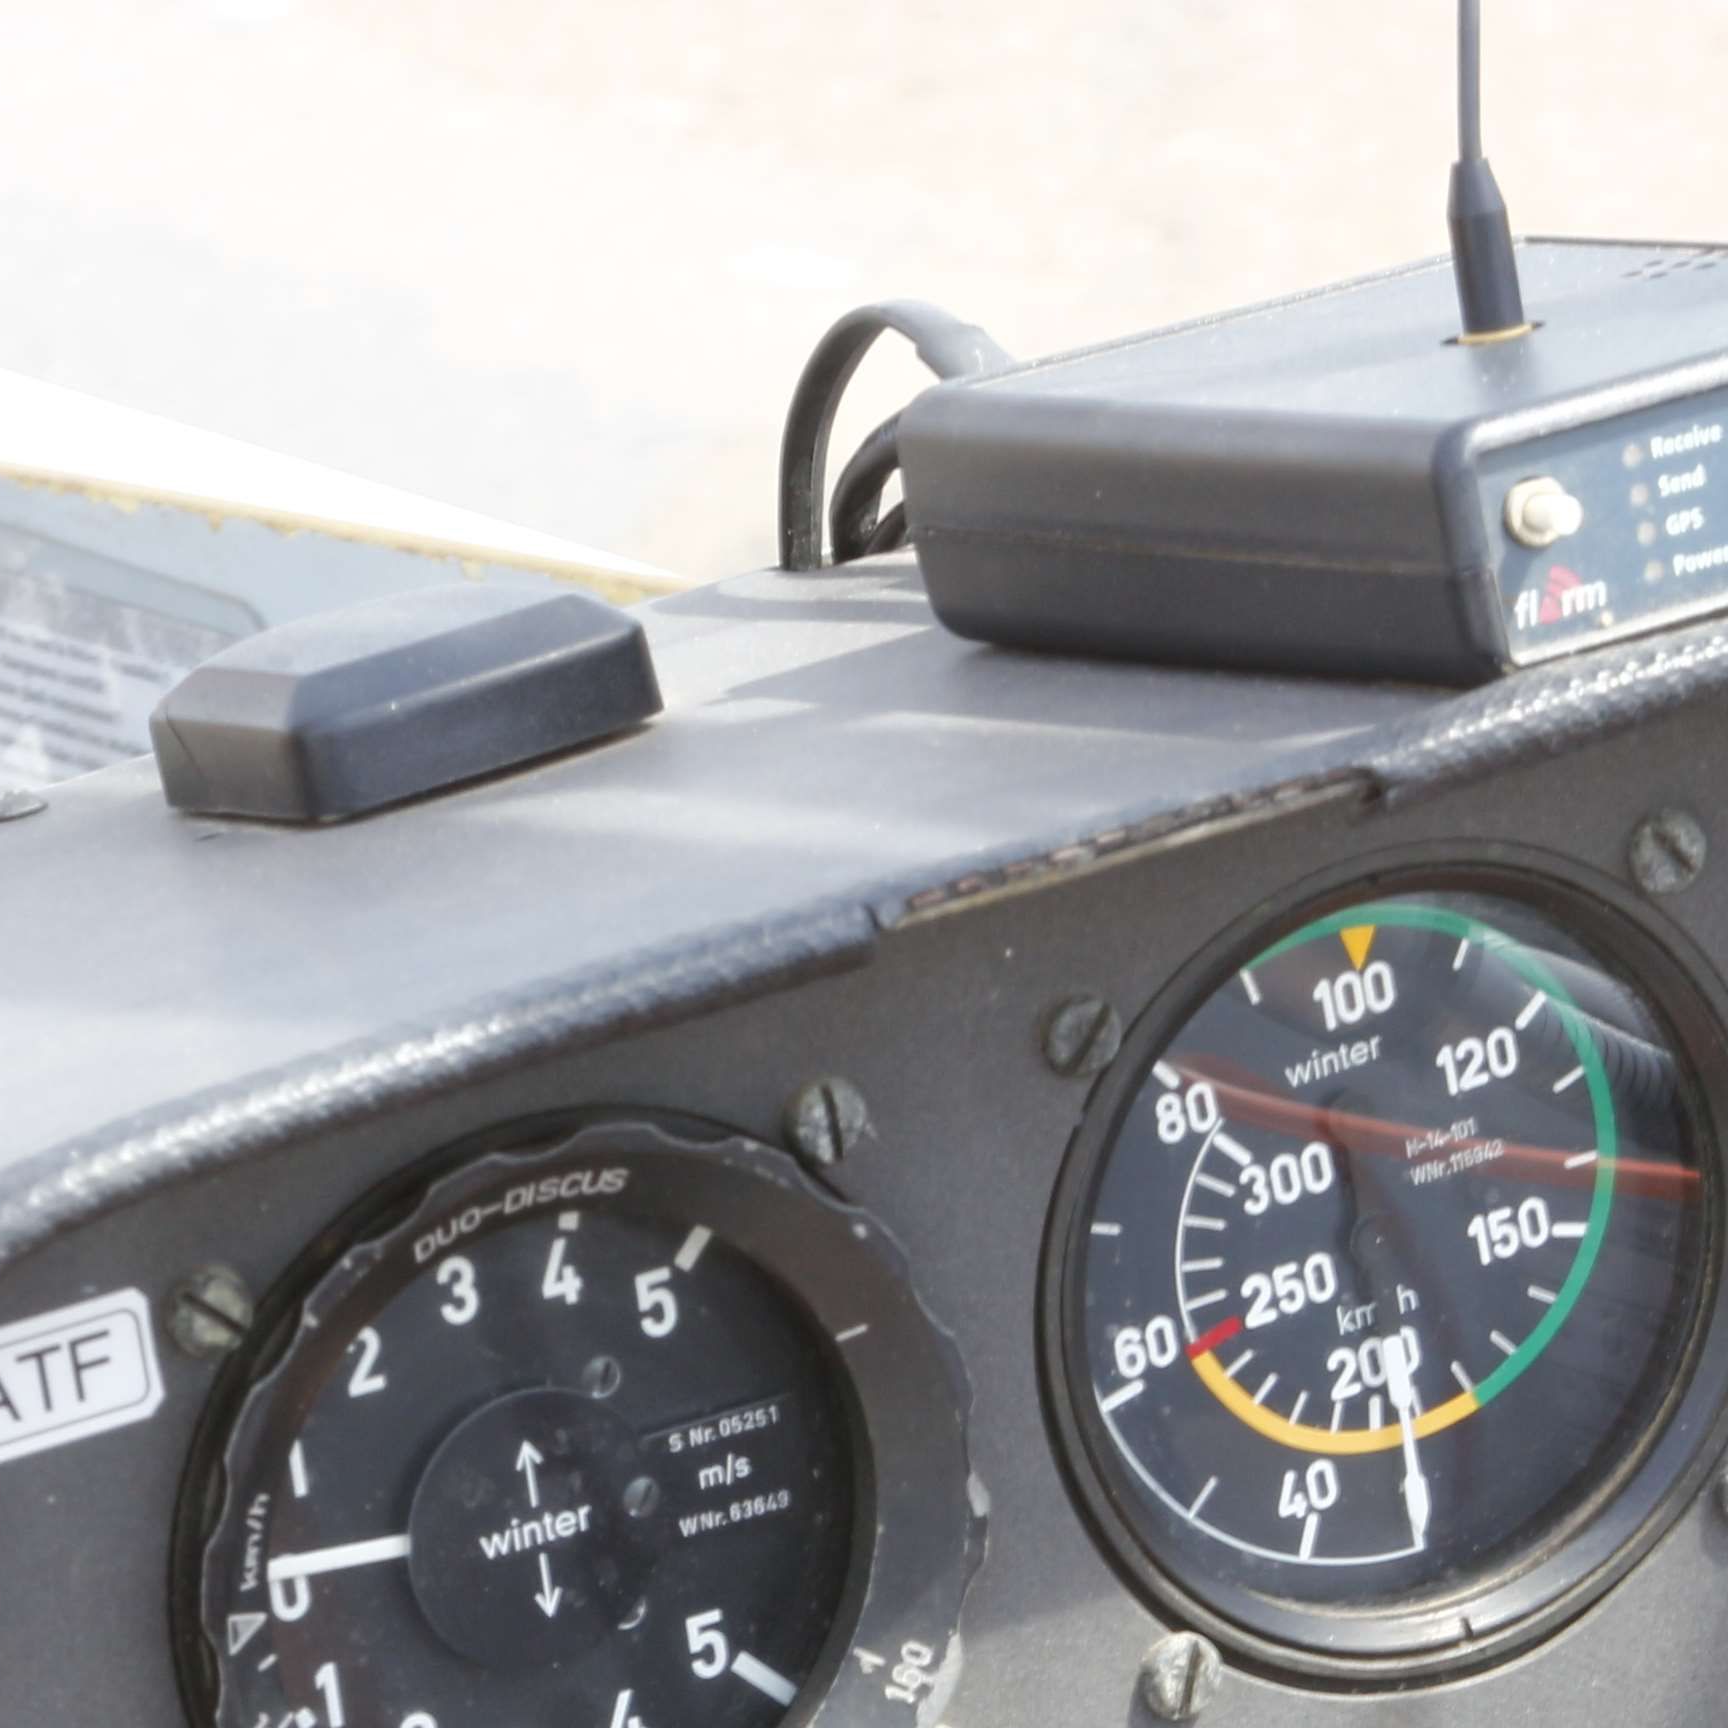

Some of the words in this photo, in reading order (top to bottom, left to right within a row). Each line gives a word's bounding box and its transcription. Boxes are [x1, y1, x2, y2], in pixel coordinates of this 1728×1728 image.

[1651, 424, 1722, 459] Receive
[1658, 463, 1706, 497] Send
[1666, 506, 1704, 536] GPS
[1313, 962, 1396, 1030] 100
[1284, 1034, 1383, 1088] winter
[1435, 1027, 1517, 1095] 120
[1155, 1083, 1220, 1143] 80
[1238, 1143, 1332, 1216] 300
[414, 1168, 629, 1263] DUO-DISCUS
[1467, 1196, 1550, 1266] 150
[436, 1256, 480, 1326] 3
[542, 1239, 581, 1305] 4
[636, 1267, 676, 1337] 5
[1240, 1254, 1338, 1327] 250
[346, 1328, 385, 1397] 2
[1114, 1315, 1178, 1380] 60
[698, 1453, 752, 1490] m/s
[1278, 1458, 1339, 1519] 40
[240, 1494, 269, 1591] km/h
[479, 1504, 592, 1561] winter
[686, 1610, 727, 1679] 5
